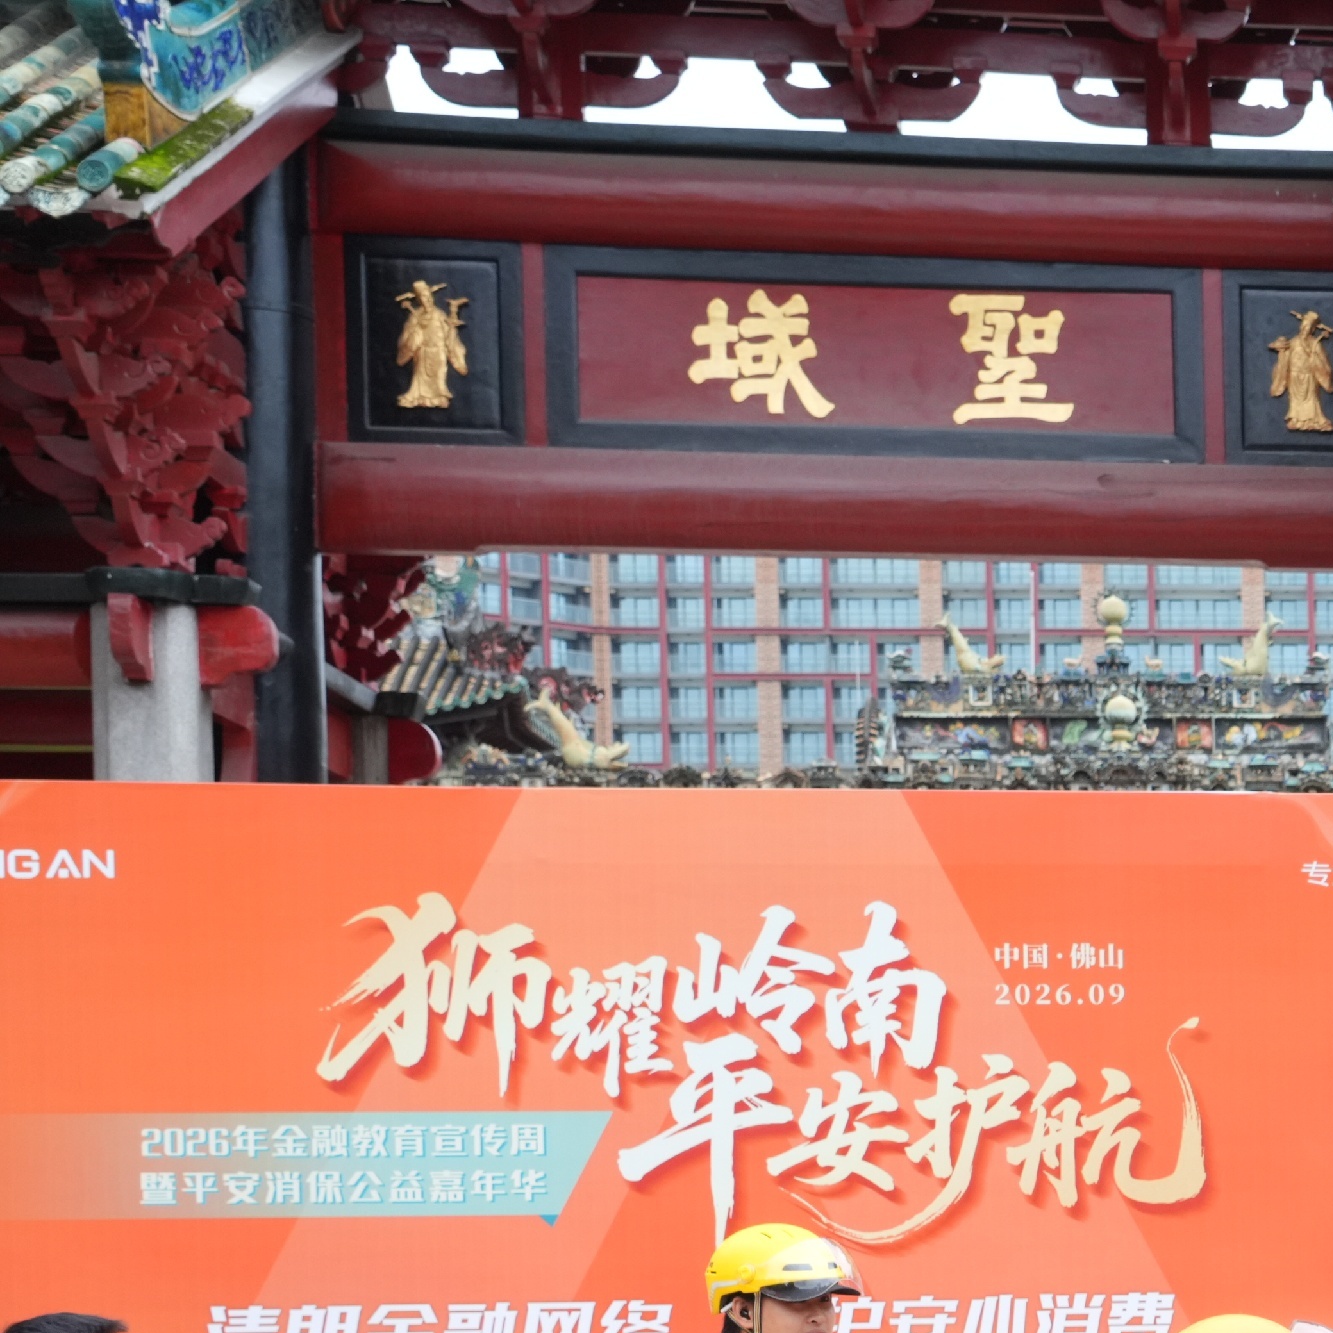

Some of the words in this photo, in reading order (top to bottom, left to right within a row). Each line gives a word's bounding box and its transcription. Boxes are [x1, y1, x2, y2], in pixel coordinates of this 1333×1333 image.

[0, 848, 116, 880] GAN
[994, 943, 1124, 971] 中国·佛山
[316, 891, 946, 1099] 狮耀岭南
[994, 983, 1126, 1007] 2026.09
[141, 1124, 546, 1158] 2026年金融教育宣传周
[617, 1017, 1206, 1248] 平安护航
[140, 1170, 547, 1206] 暨平安消保公益嘉年华
